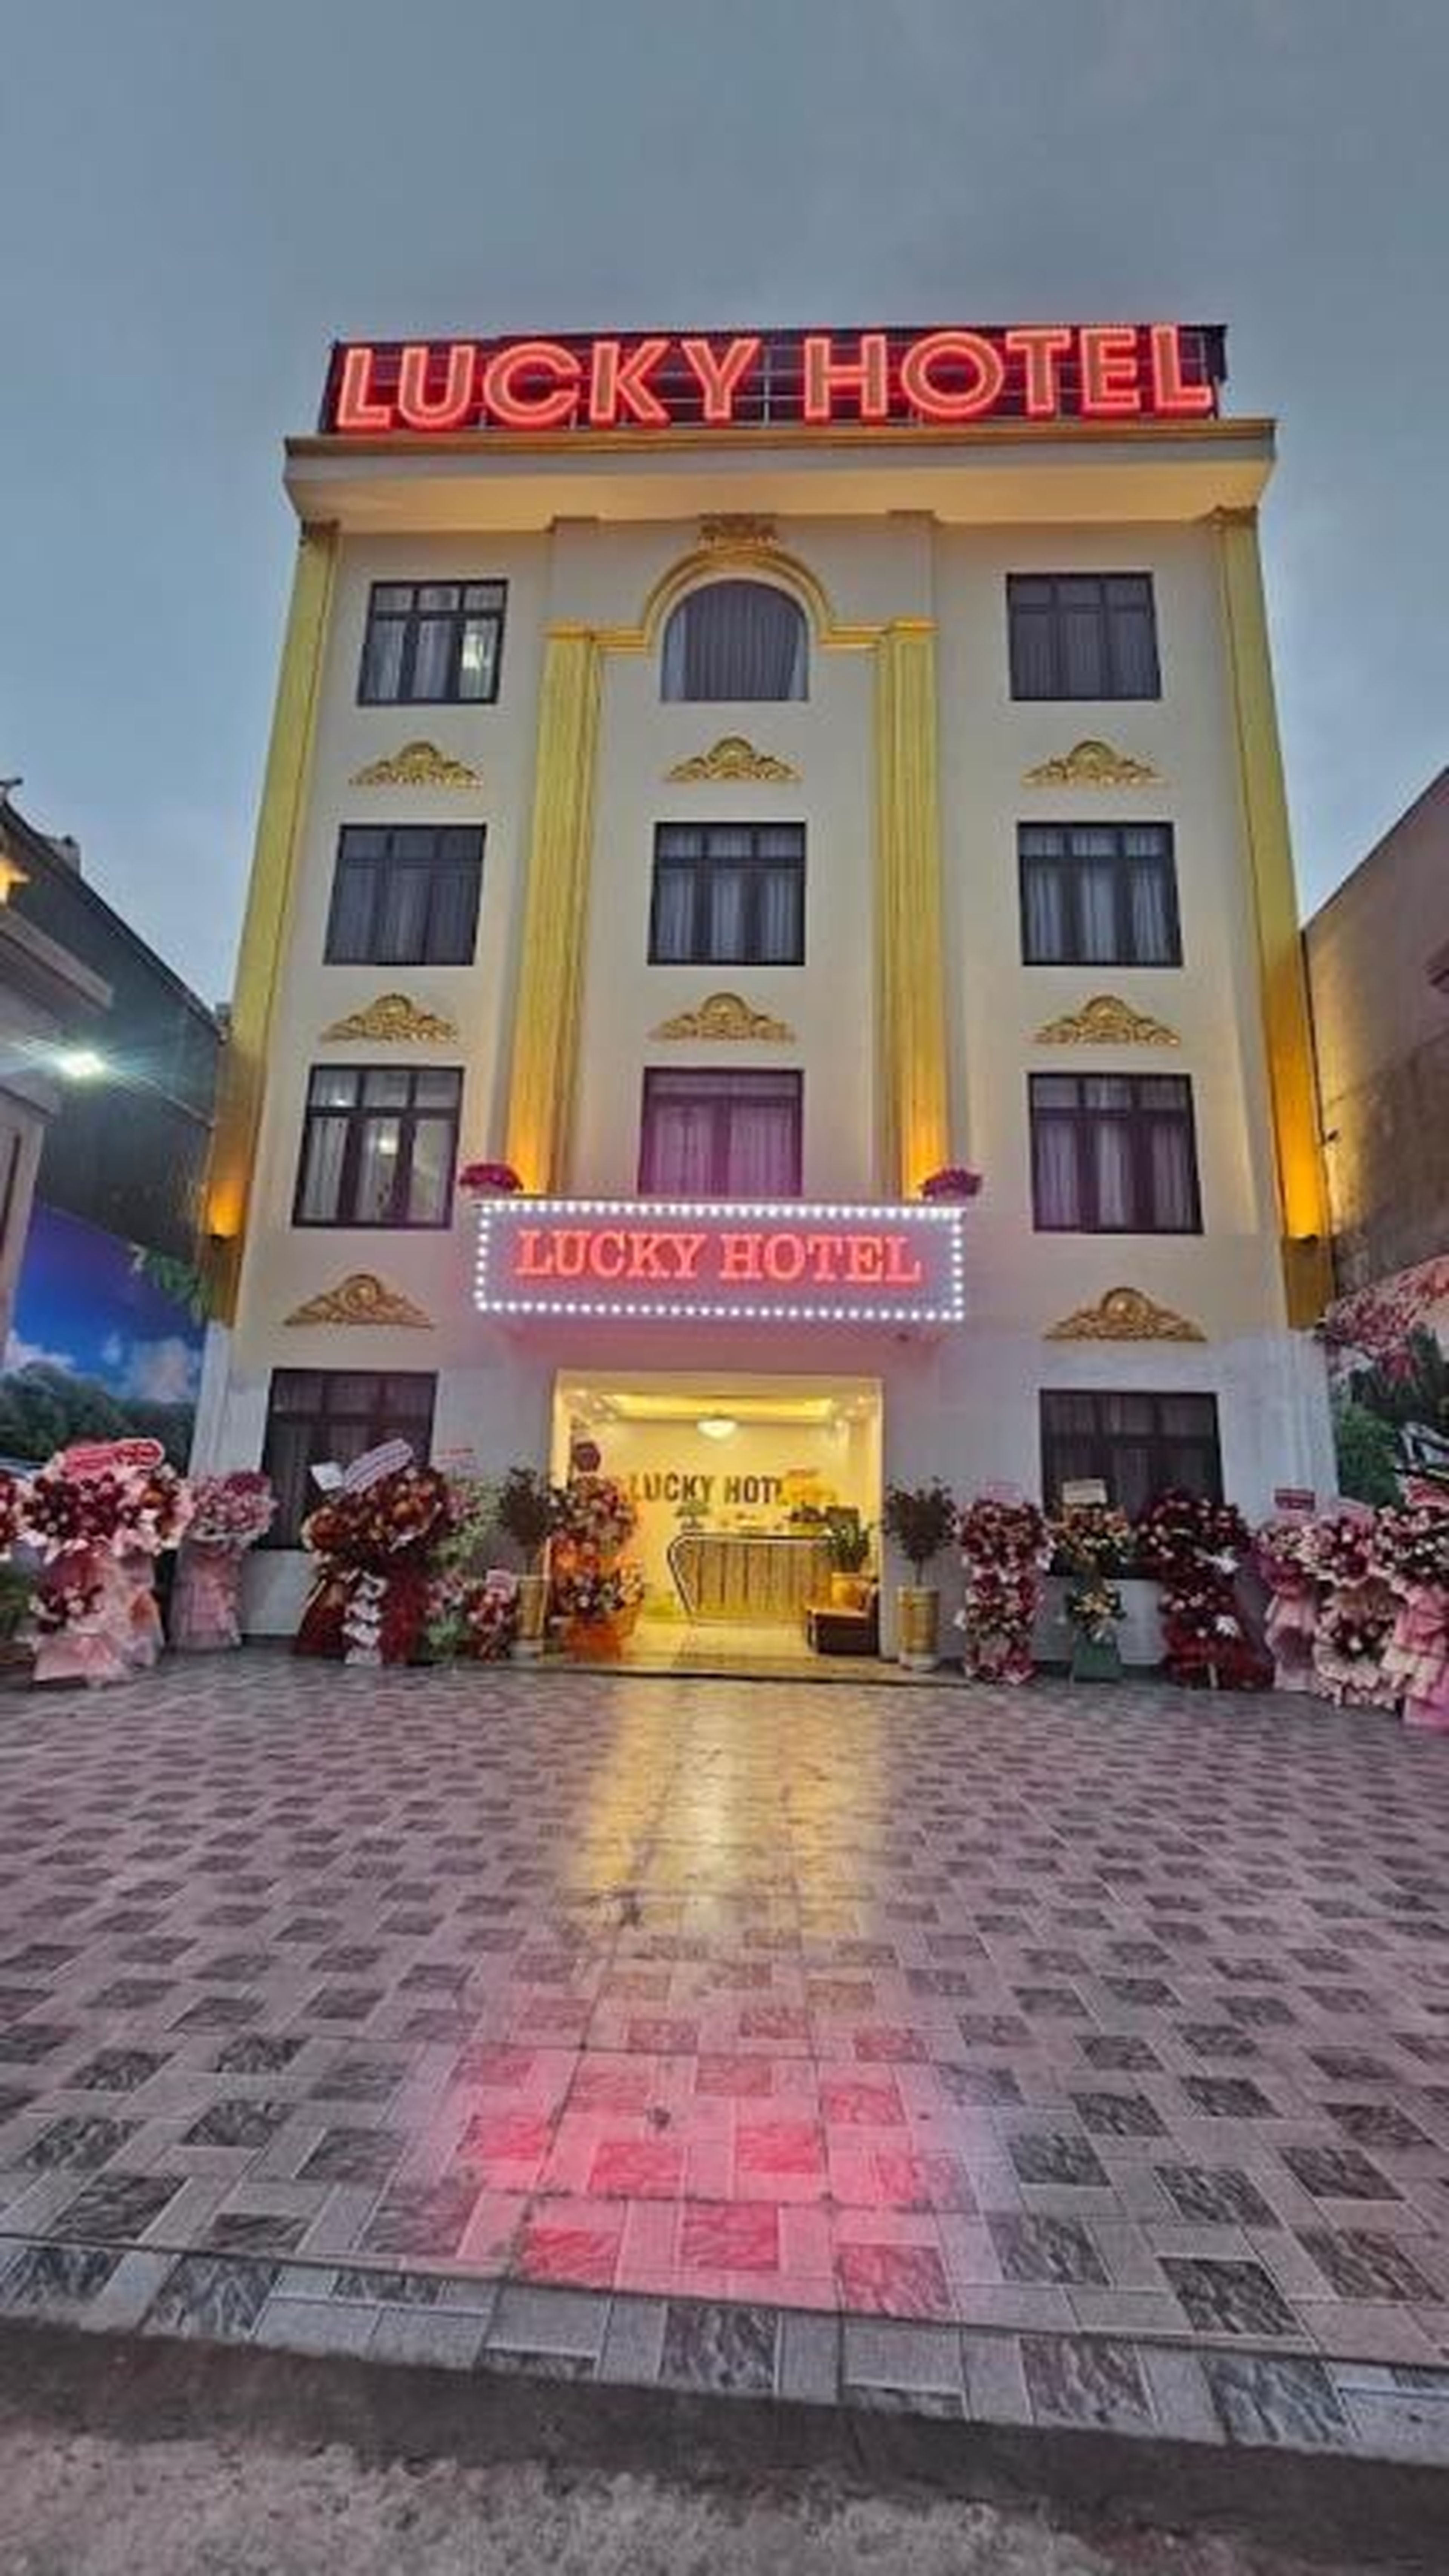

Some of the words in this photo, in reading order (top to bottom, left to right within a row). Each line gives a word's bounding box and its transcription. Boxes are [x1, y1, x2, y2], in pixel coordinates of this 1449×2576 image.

[337, 338, 760, 430] LUCKY
[804, 325, 1213, 420] HOTEL
[515, 1229, 707, 1279] LUCKY
[718, 1232, 922, 1282] HOTEL
[629, 1472, 715, 1503] LUCKY
[724, 1475, 782, 1504] HOT
